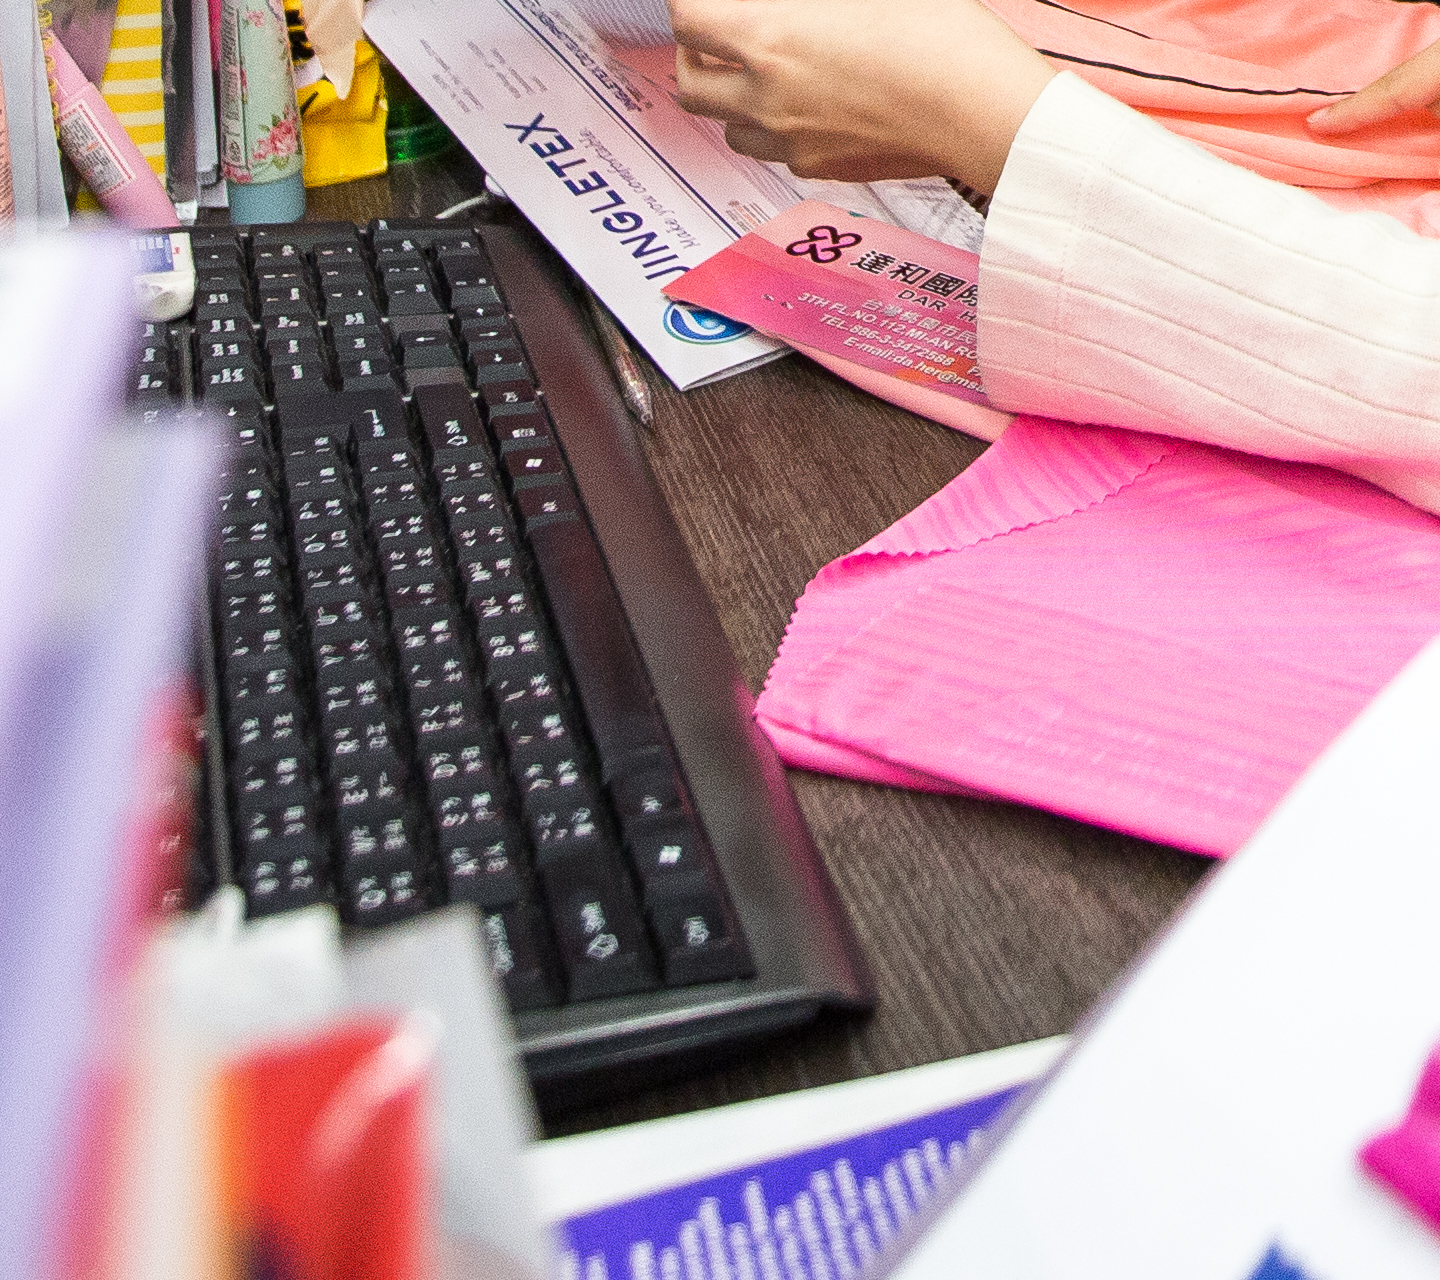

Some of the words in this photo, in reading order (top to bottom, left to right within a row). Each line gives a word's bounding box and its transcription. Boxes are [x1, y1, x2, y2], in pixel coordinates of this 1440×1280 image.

[503, 112, 694, 281] JINGLETEX
[798, 292, 830, 308] 3TH
[898, 289, 947, 312] DAR
